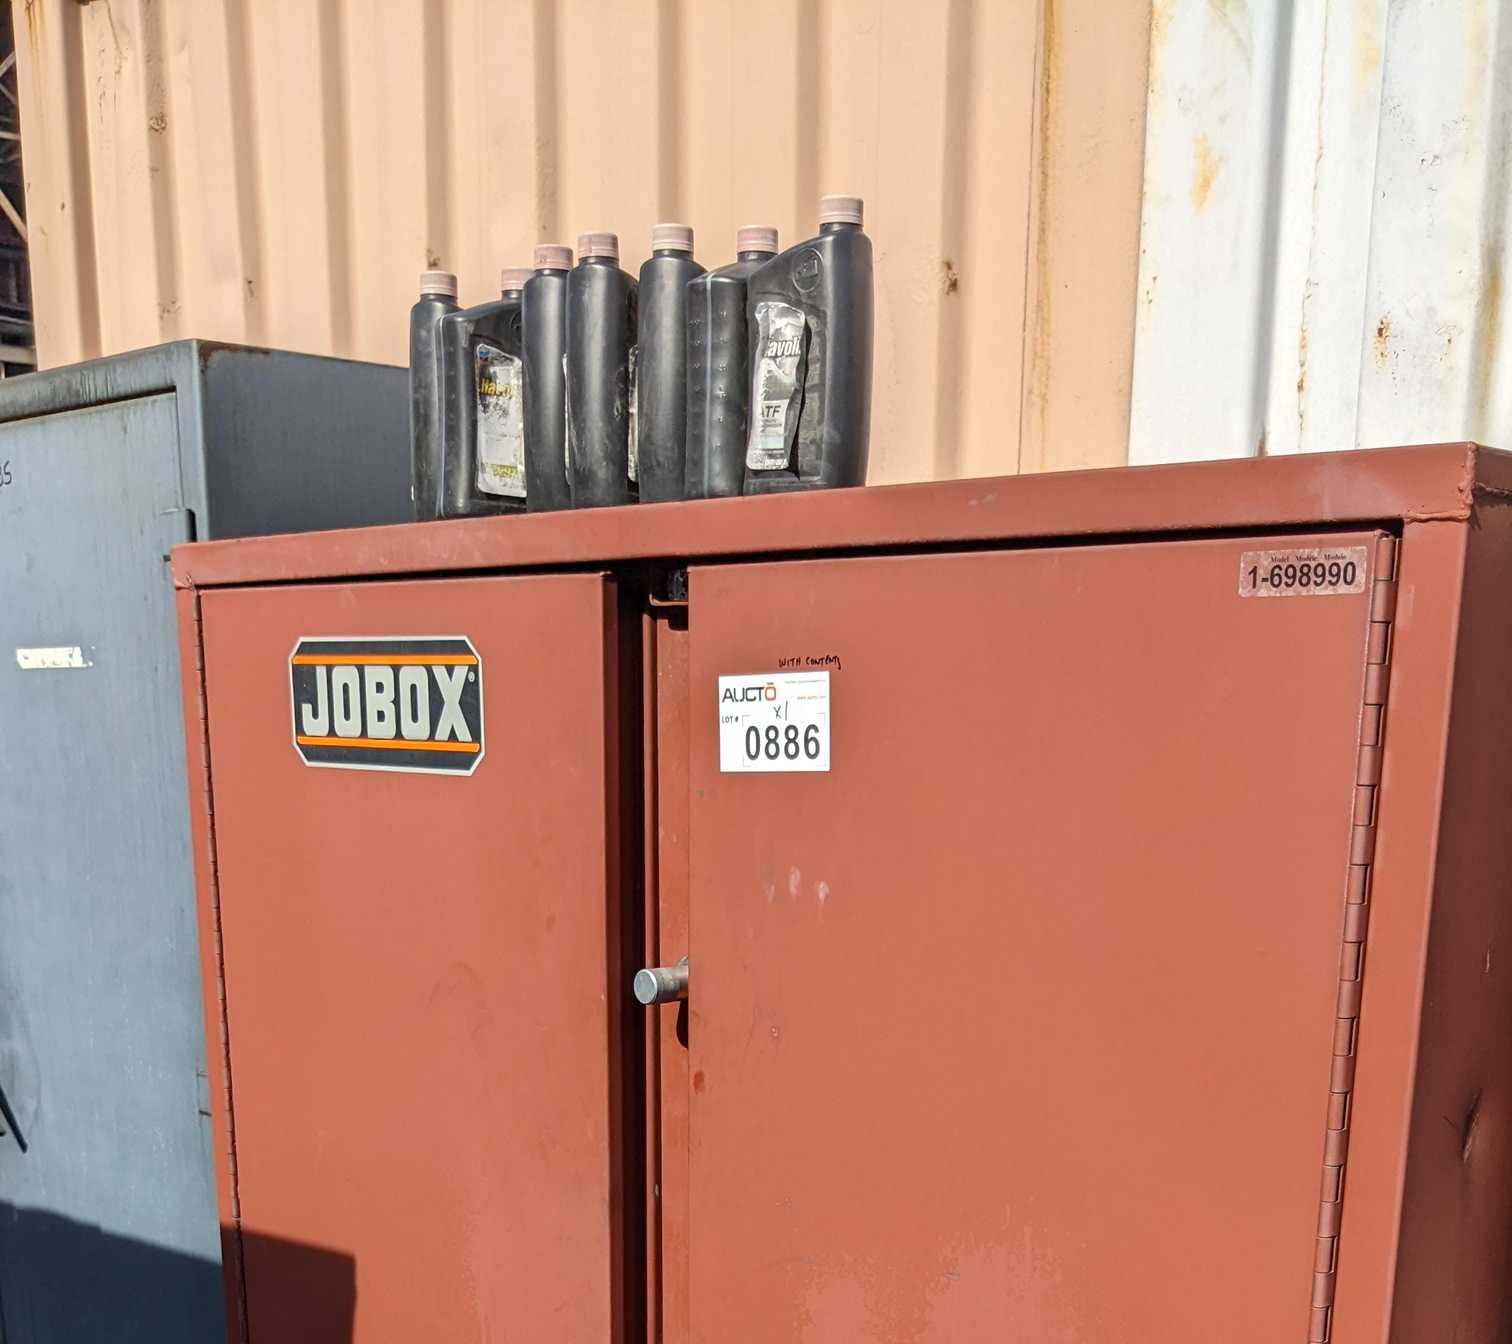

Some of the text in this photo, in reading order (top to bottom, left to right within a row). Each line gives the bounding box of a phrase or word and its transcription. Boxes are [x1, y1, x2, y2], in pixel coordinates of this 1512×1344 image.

[1248, 561, 1357, 589] 1-698990
[779, 656, 801, 668] WITH
[721, 715, 733, 724] LOT
[745, 723, 821, 761] 0886
